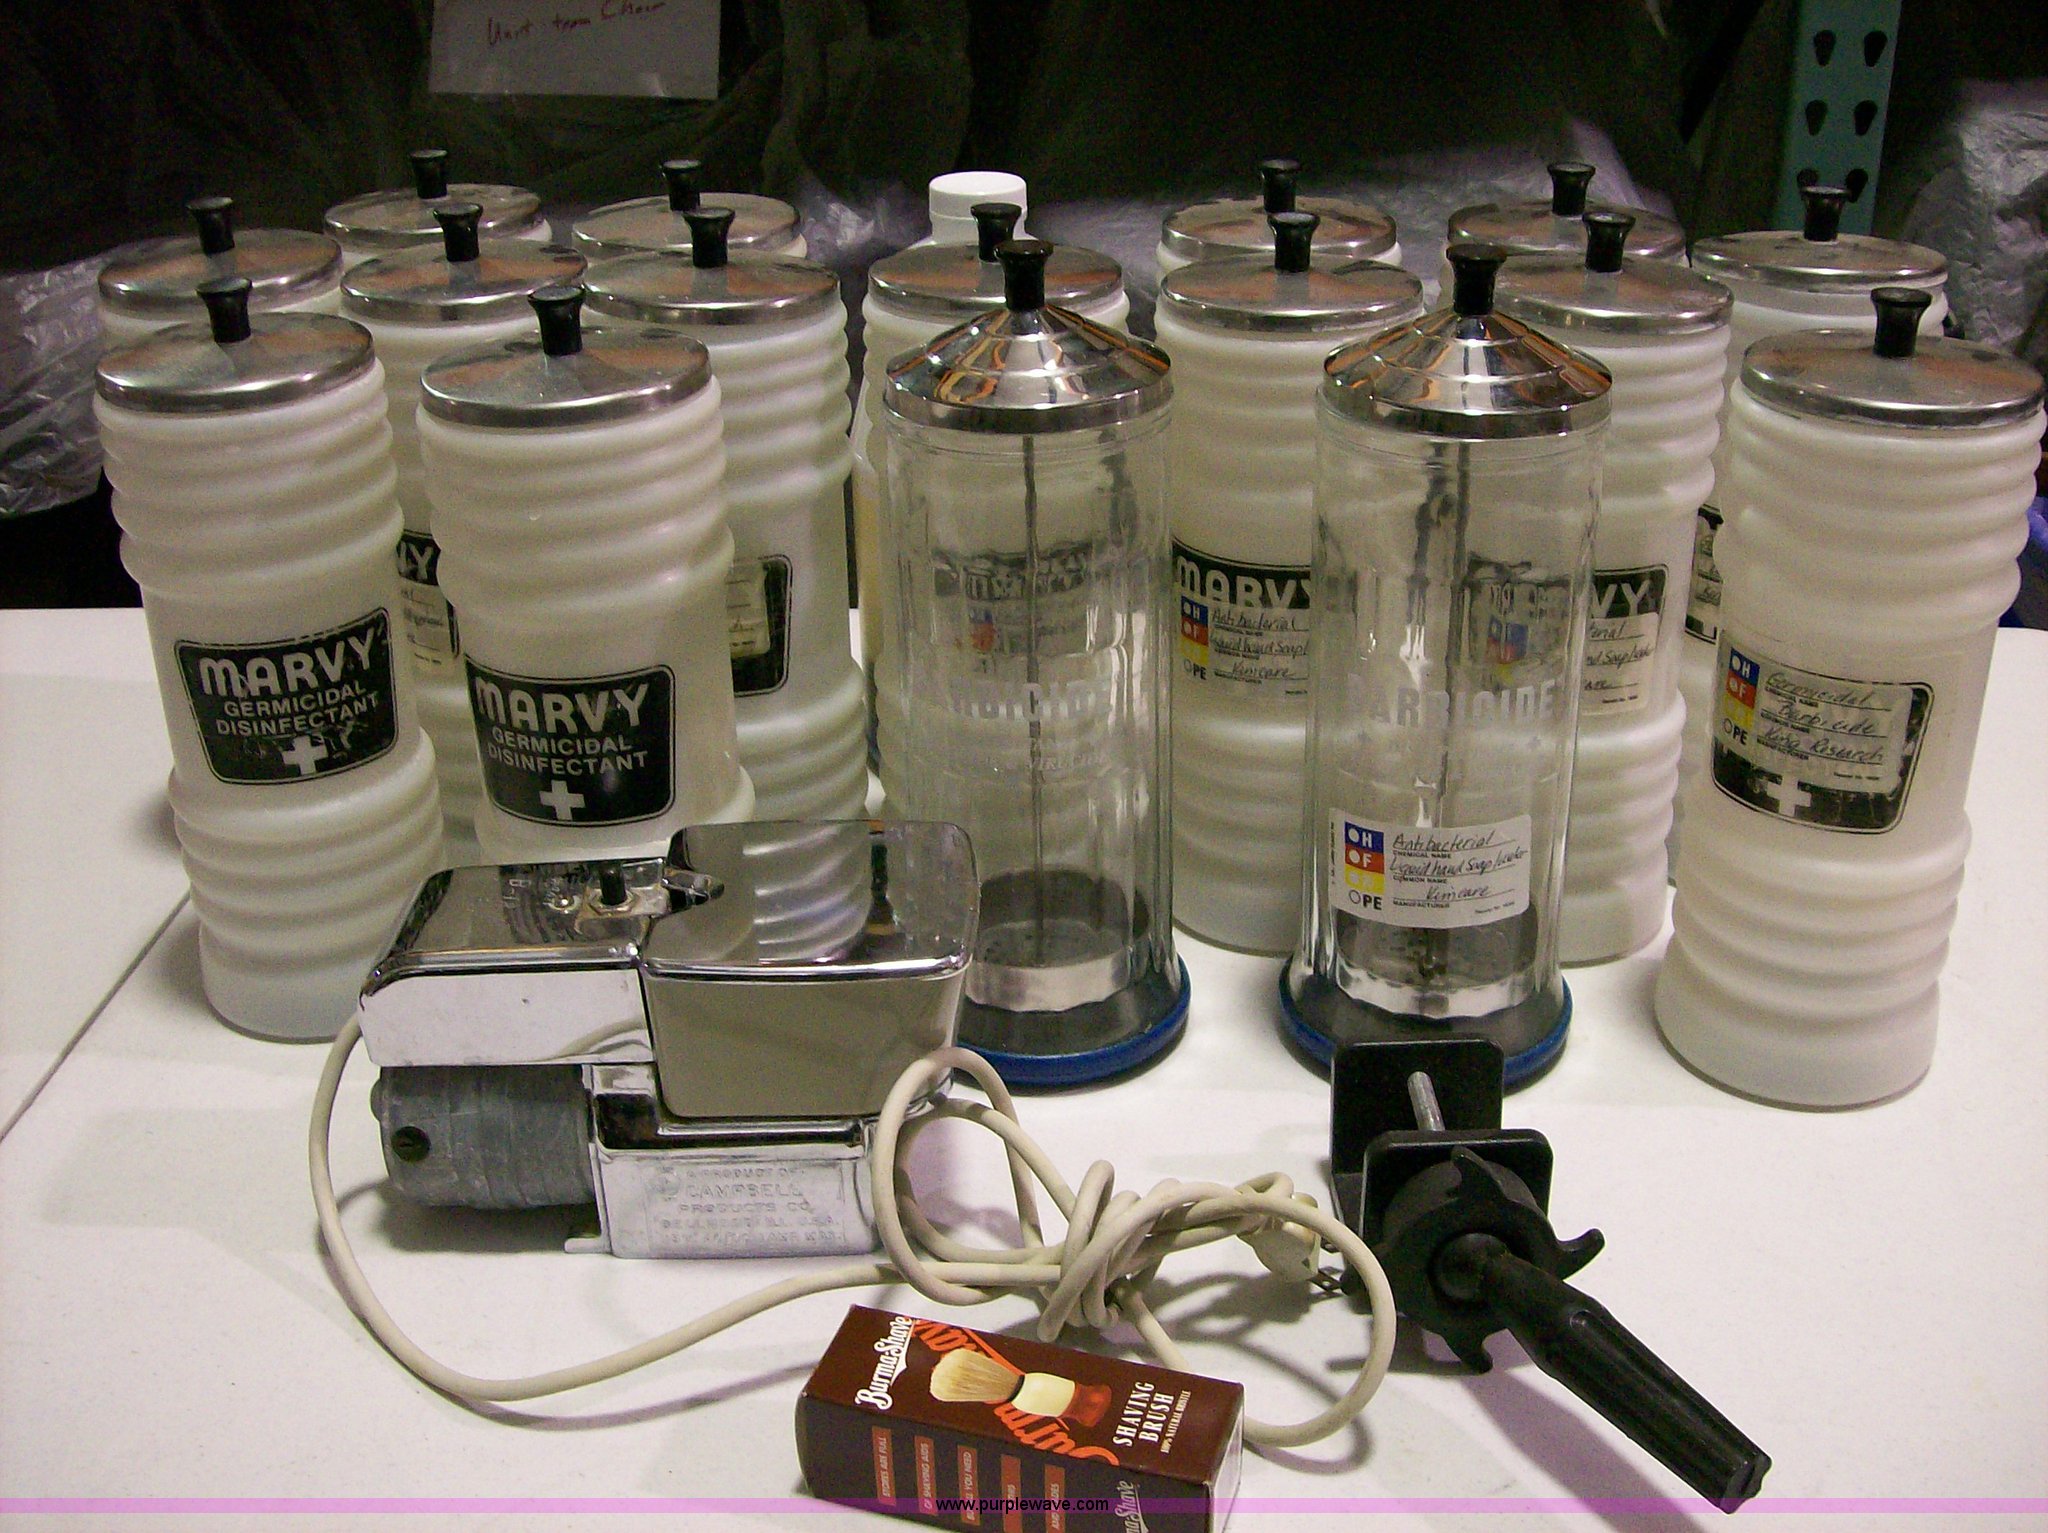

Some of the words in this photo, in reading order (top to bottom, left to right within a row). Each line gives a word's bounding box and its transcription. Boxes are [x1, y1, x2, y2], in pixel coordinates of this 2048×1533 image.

[198, 627, 376, 698] MARVY
[216, 691, 379, 737] DISINFECTANT
[223, 680, 367, 718] GERMICIDAL
[474, 681, 651, 735] MARVY
[486, 749, 649, 777] DISINFECTANT
[491, 724, 633, 757] GERMICIDAL
[686, 1182, 804, 1199] CAMPBELL
[1112, 1381, 1156, 1447] SHAVING
[1138, 1392, 1175, 1443] BRUSH
